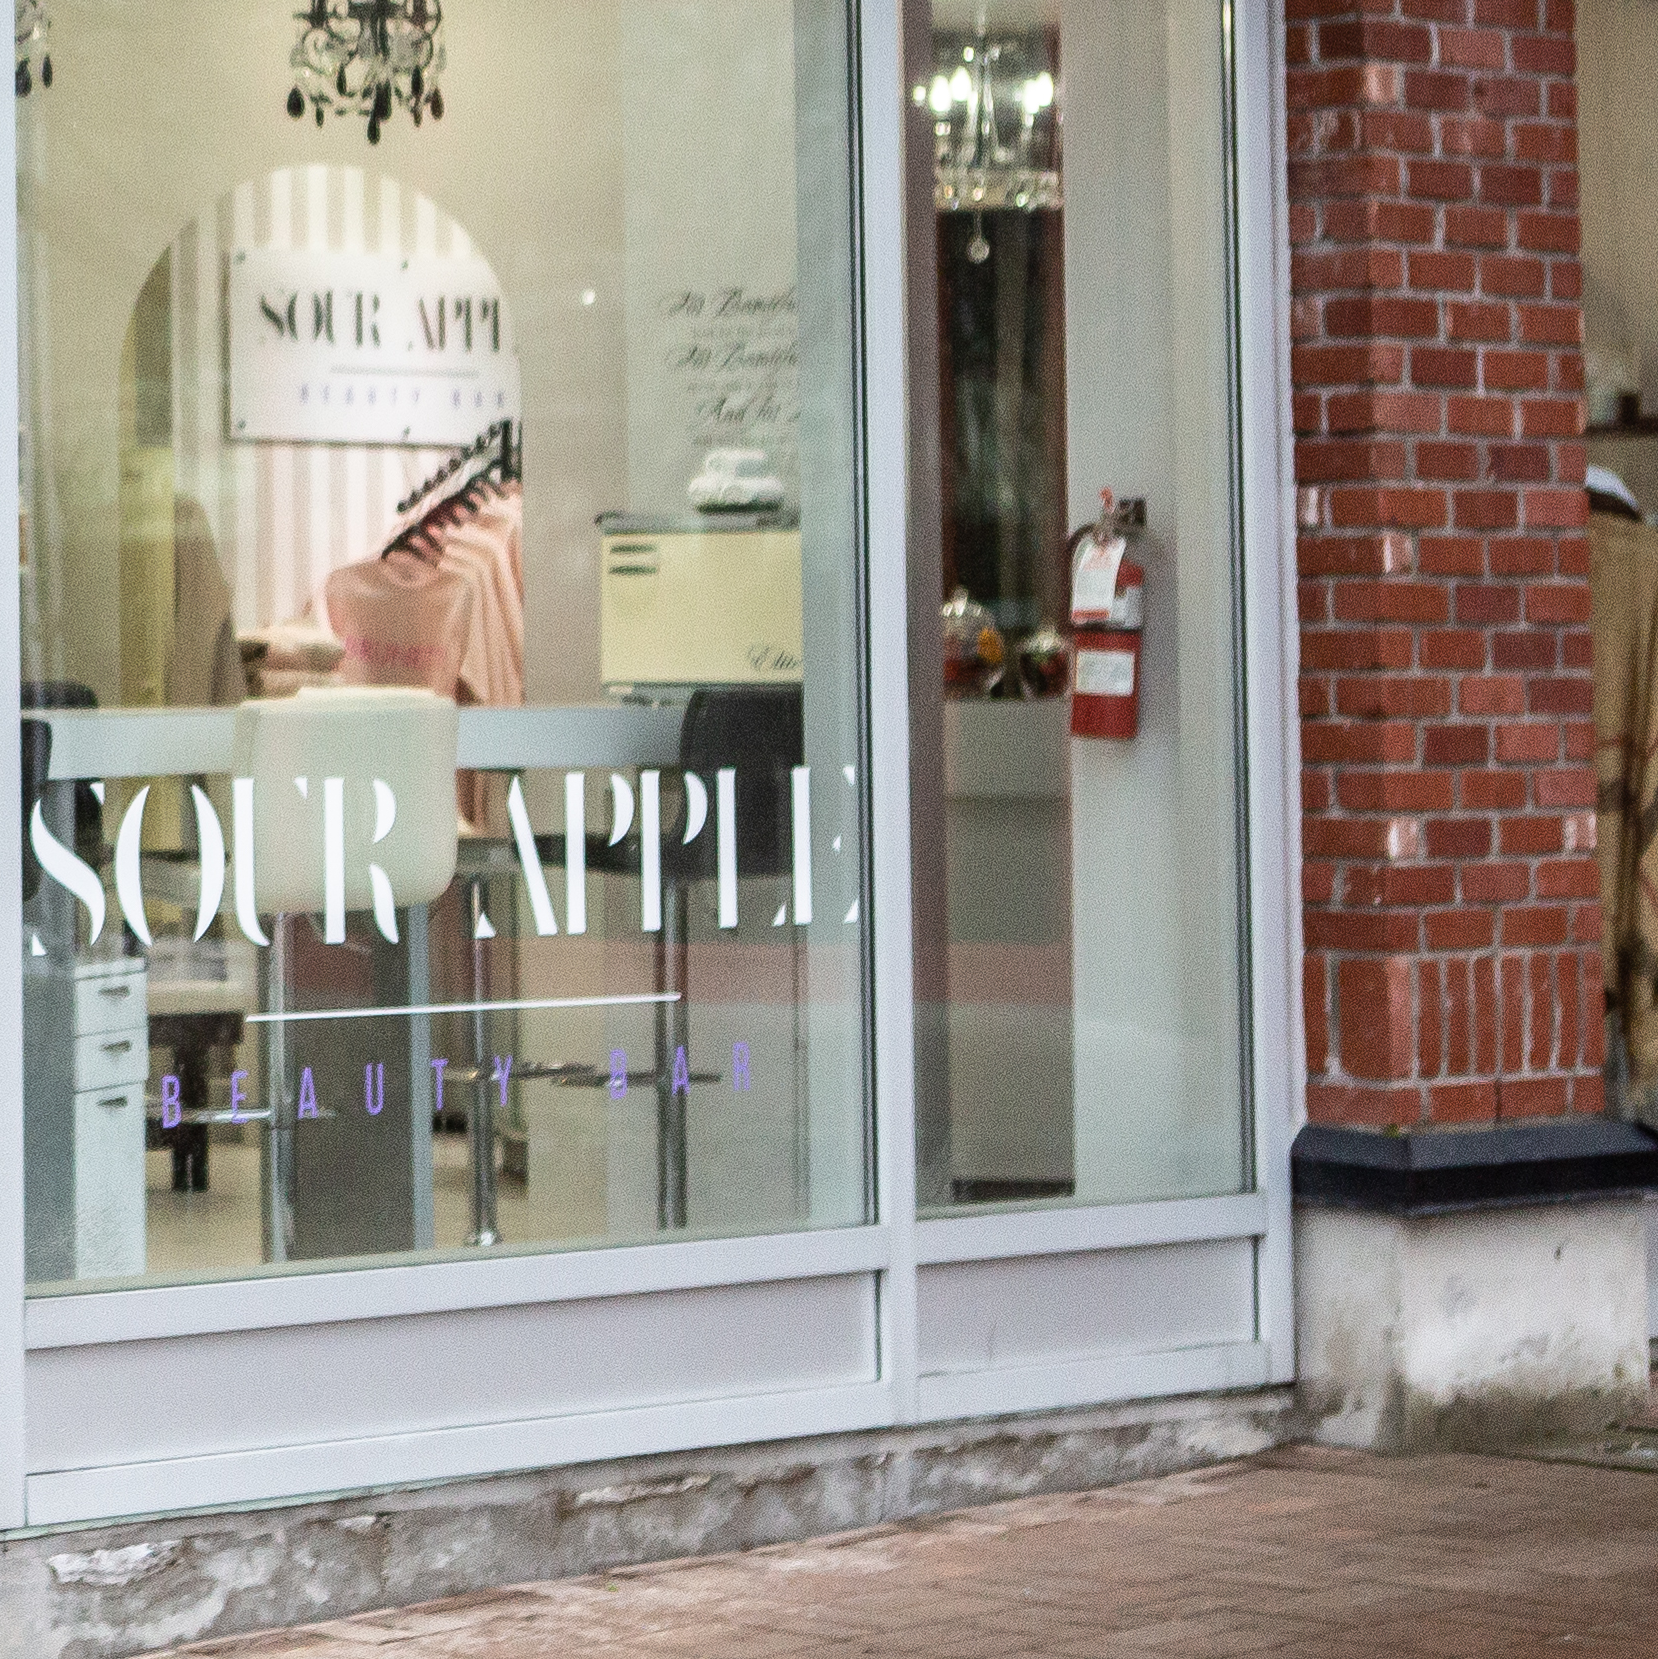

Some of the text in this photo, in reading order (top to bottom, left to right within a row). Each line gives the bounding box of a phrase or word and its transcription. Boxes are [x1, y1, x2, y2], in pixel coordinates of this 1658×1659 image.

[259, 288, 515, 353] SOUR APPL
[29, 764, 860, 958] SOUR APPLE
[160, 1041, 753, 1130] BEAUTY BAR
